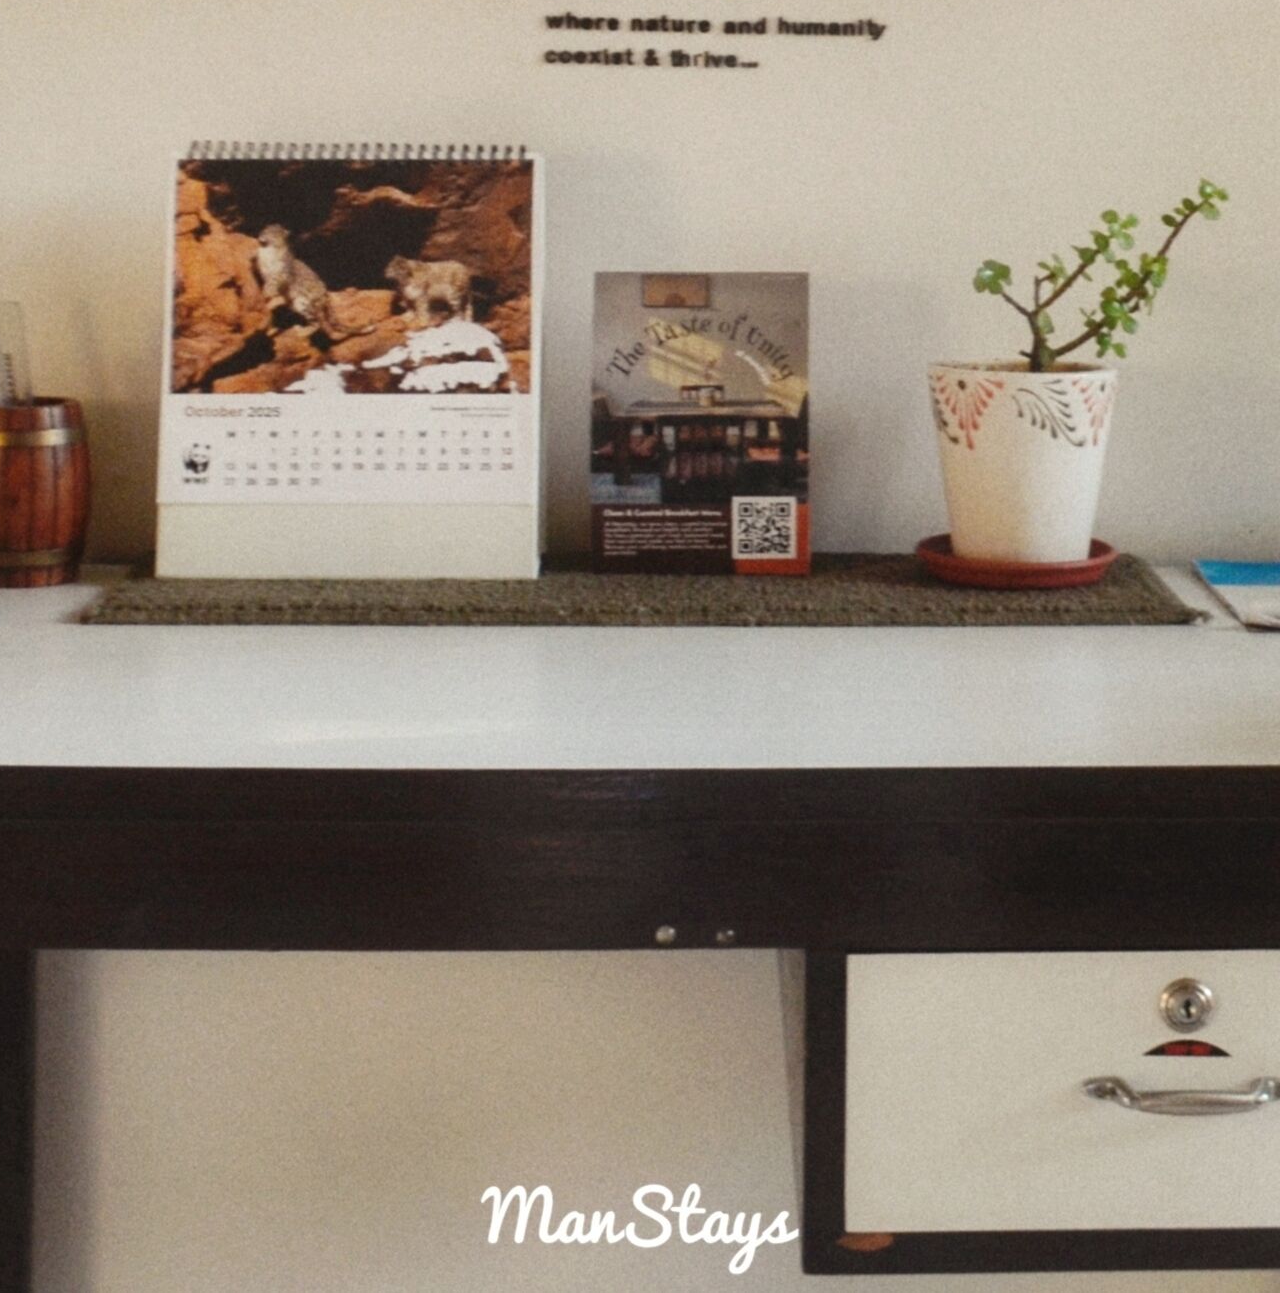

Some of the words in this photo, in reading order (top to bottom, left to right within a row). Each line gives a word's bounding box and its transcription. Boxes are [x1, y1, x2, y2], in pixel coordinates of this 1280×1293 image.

[544, 11, 620, 31] where
[629, 14, 712, 33] nature
[722, 17, 768, 35] and
[776, 17, 887, 41] humanity
[543, 48, 634, 66] coexist
[643, 48, 661, 67] &
[606, 341, 646, 377] The
[644, 314, 712, 346] Taste
[718, 314, 748, 341] of
[747, 320, 794, 382] Unity
[184, 405, 243, 418] October
[246, 405, 281, 418] 2025
